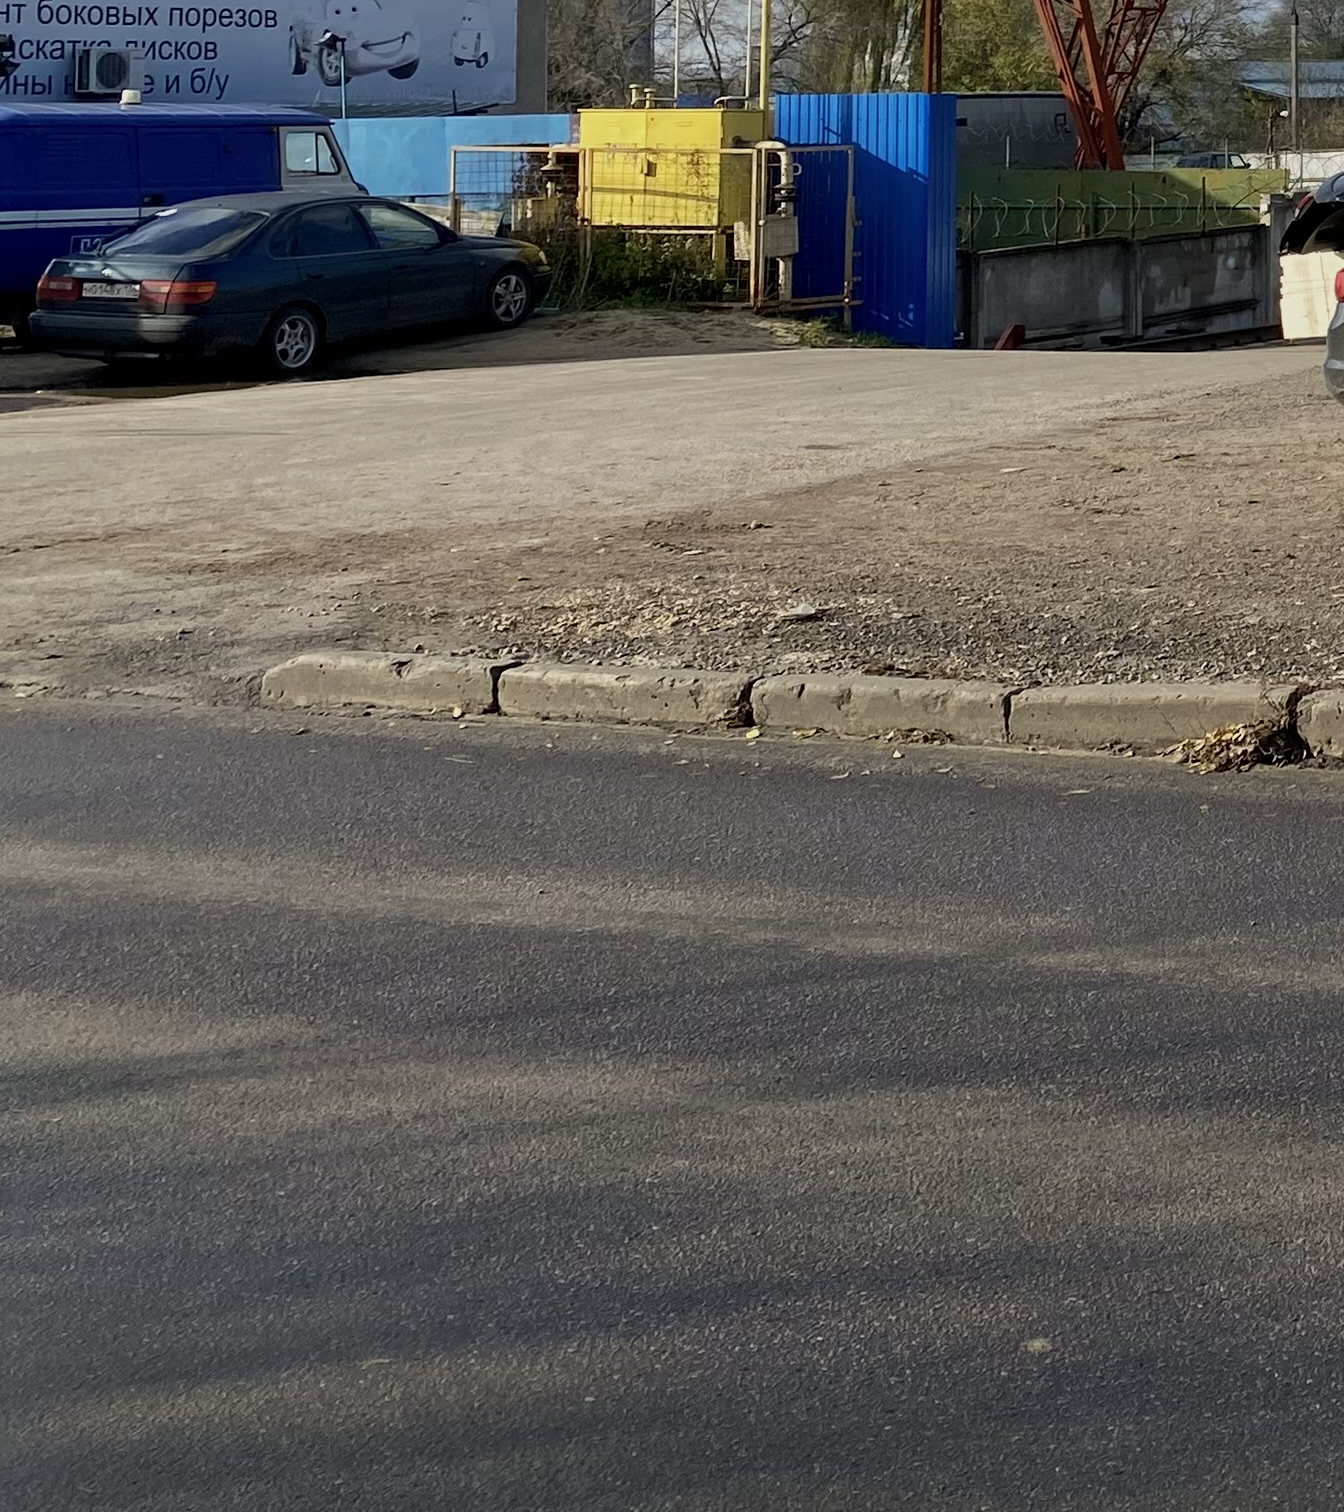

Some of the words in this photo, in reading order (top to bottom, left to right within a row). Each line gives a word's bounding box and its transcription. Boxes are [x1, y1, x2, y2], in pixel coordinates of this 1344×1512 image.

[169, 7, 278, 33] порезов
[166, 74, 180, 94] и
[190, 68, 229, 100] б/у
